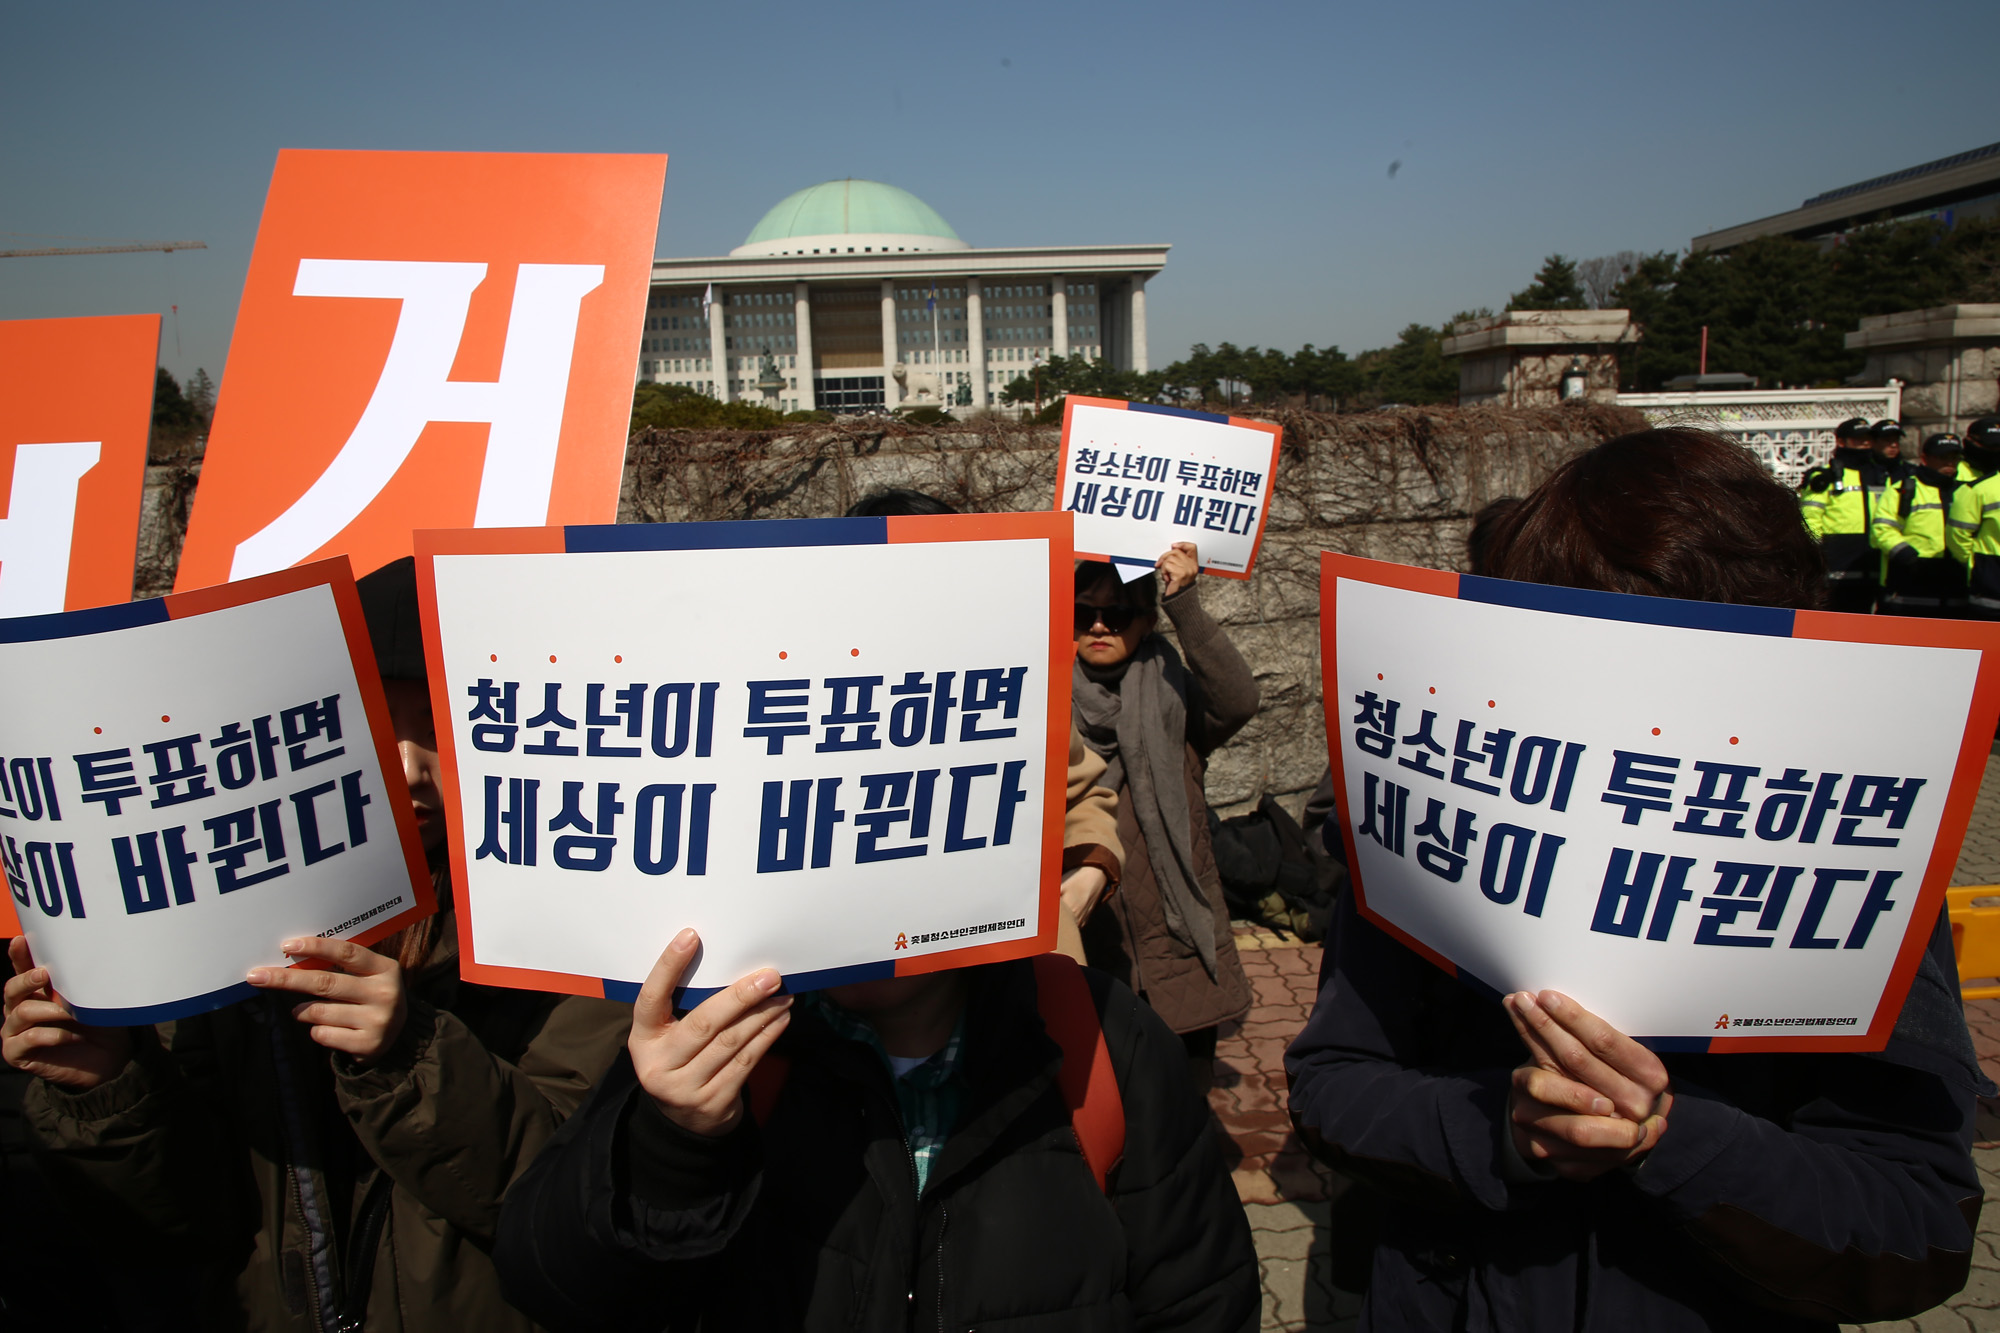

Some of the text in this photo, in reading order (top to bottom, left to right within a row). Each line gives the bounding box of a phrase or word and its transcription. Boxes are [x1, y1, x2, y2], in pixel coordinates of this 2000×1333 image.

[1067, 482, 1256, 536] 세상이 바뀐다
[1075, 448, 1262, 498] 청소년이 투표하면
[73, 694, 346, 816] 투표하면
[468, 667, 1028, 758] 청소년이 투표하면
[1354, 691, 1927, 847] 청소년이 투표하면
[111, 769, 372, 915] 바뀐다
[475, 760, 1027, 876] 세상이 바뀐다
[1358, 771, 1903, 949] 세상이 바뀐다
